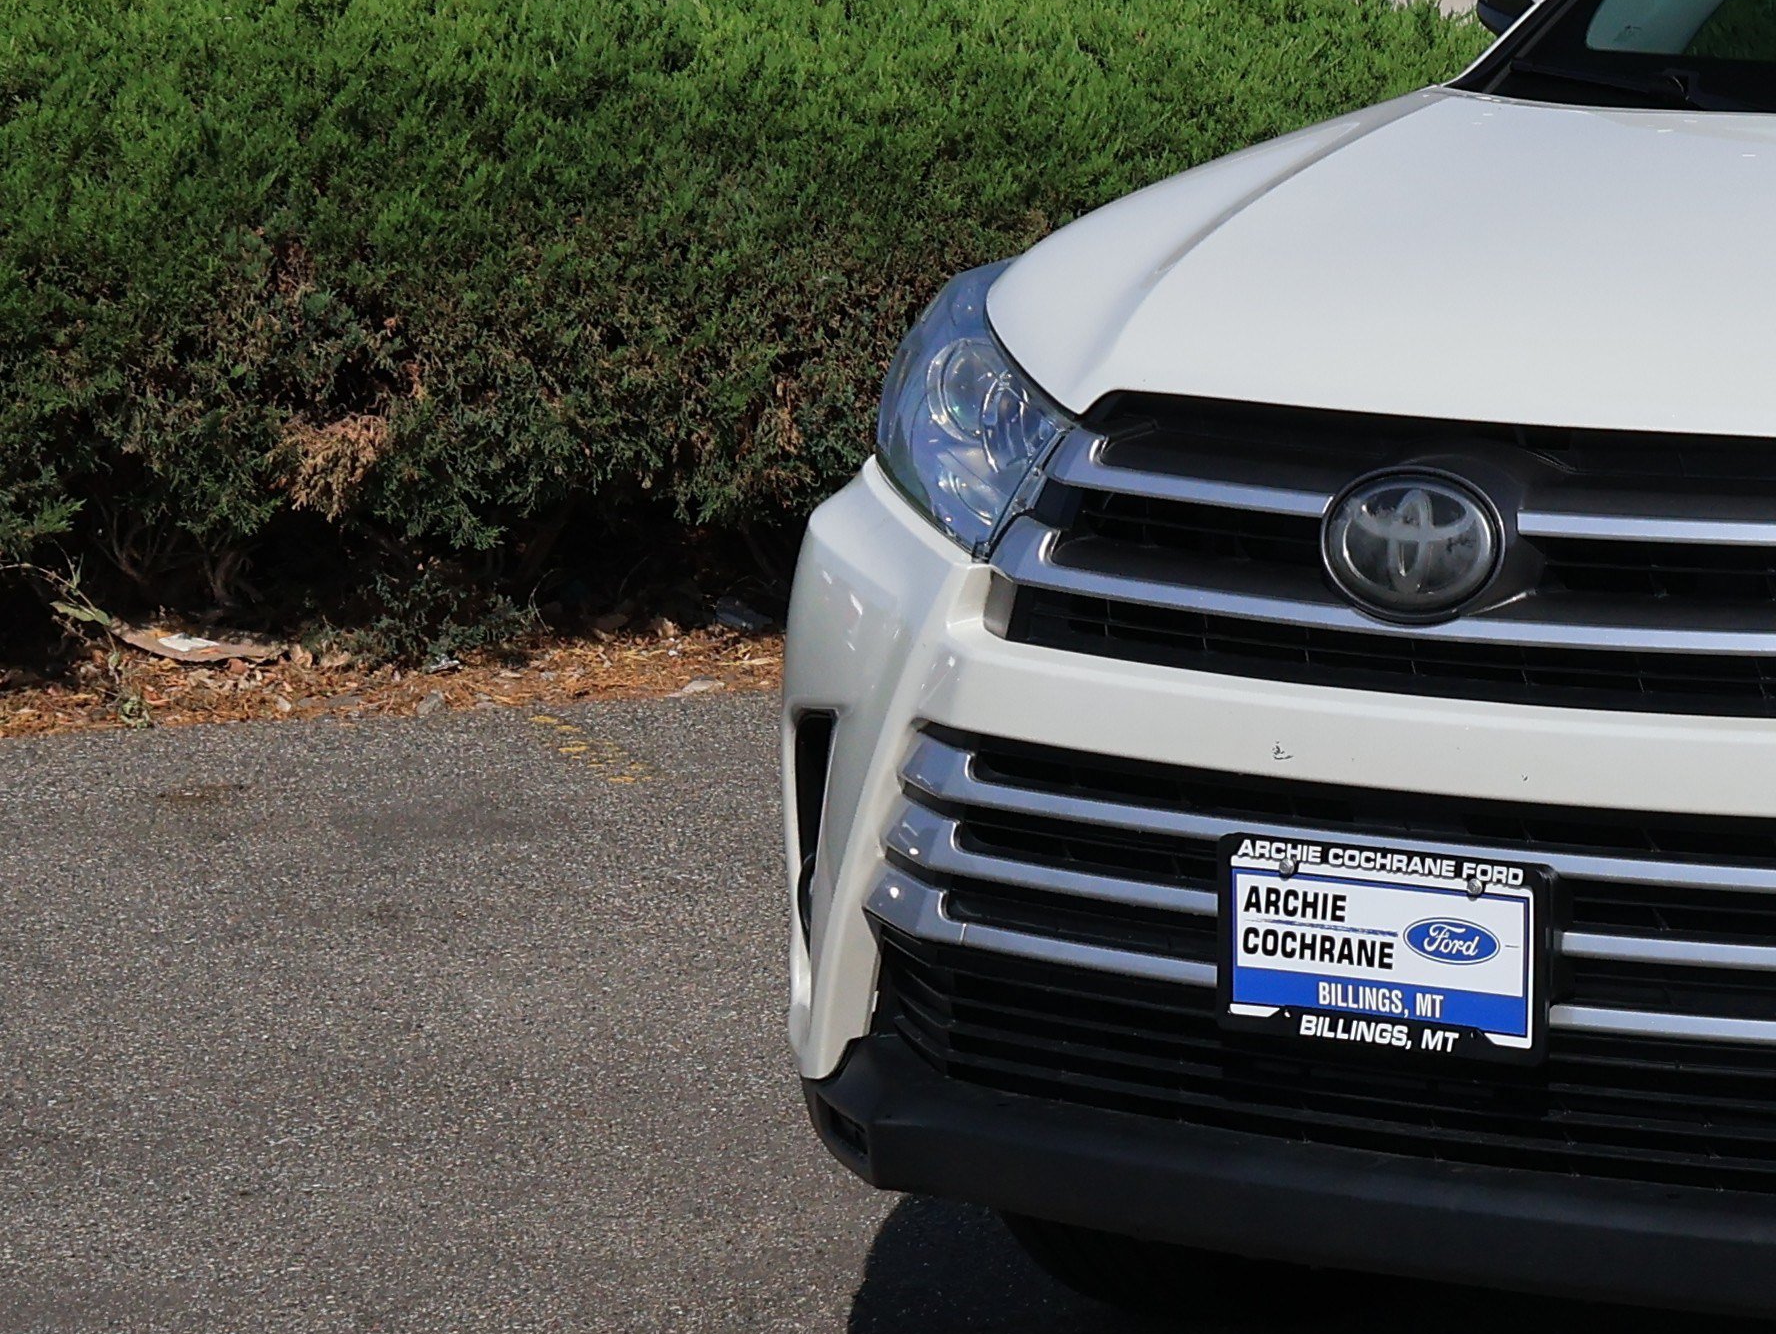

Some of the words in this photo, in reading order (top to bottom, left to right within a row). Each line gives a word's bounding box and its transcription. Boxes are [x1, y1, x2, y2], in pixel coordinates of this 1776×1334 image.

[1237, 840, 1323, 864] ARCHIE
[1328, 848, 1455, 877] COCHRANE
[1462, 863, 1524, 885] FORD
[1243, 885, 1347, 922] ARCHIE
[1242, 927, 1394, 969] COCHRANE
[1423, 923, 1480, 957] Ford
[1318, 982, 1410, 1018] BILLINGS,
[1415, 993, 1444, 1018] MT
[1300, 1014, 1412, 1050] BILLINGS,
[1421, 1029, 1459, 1053] MT
